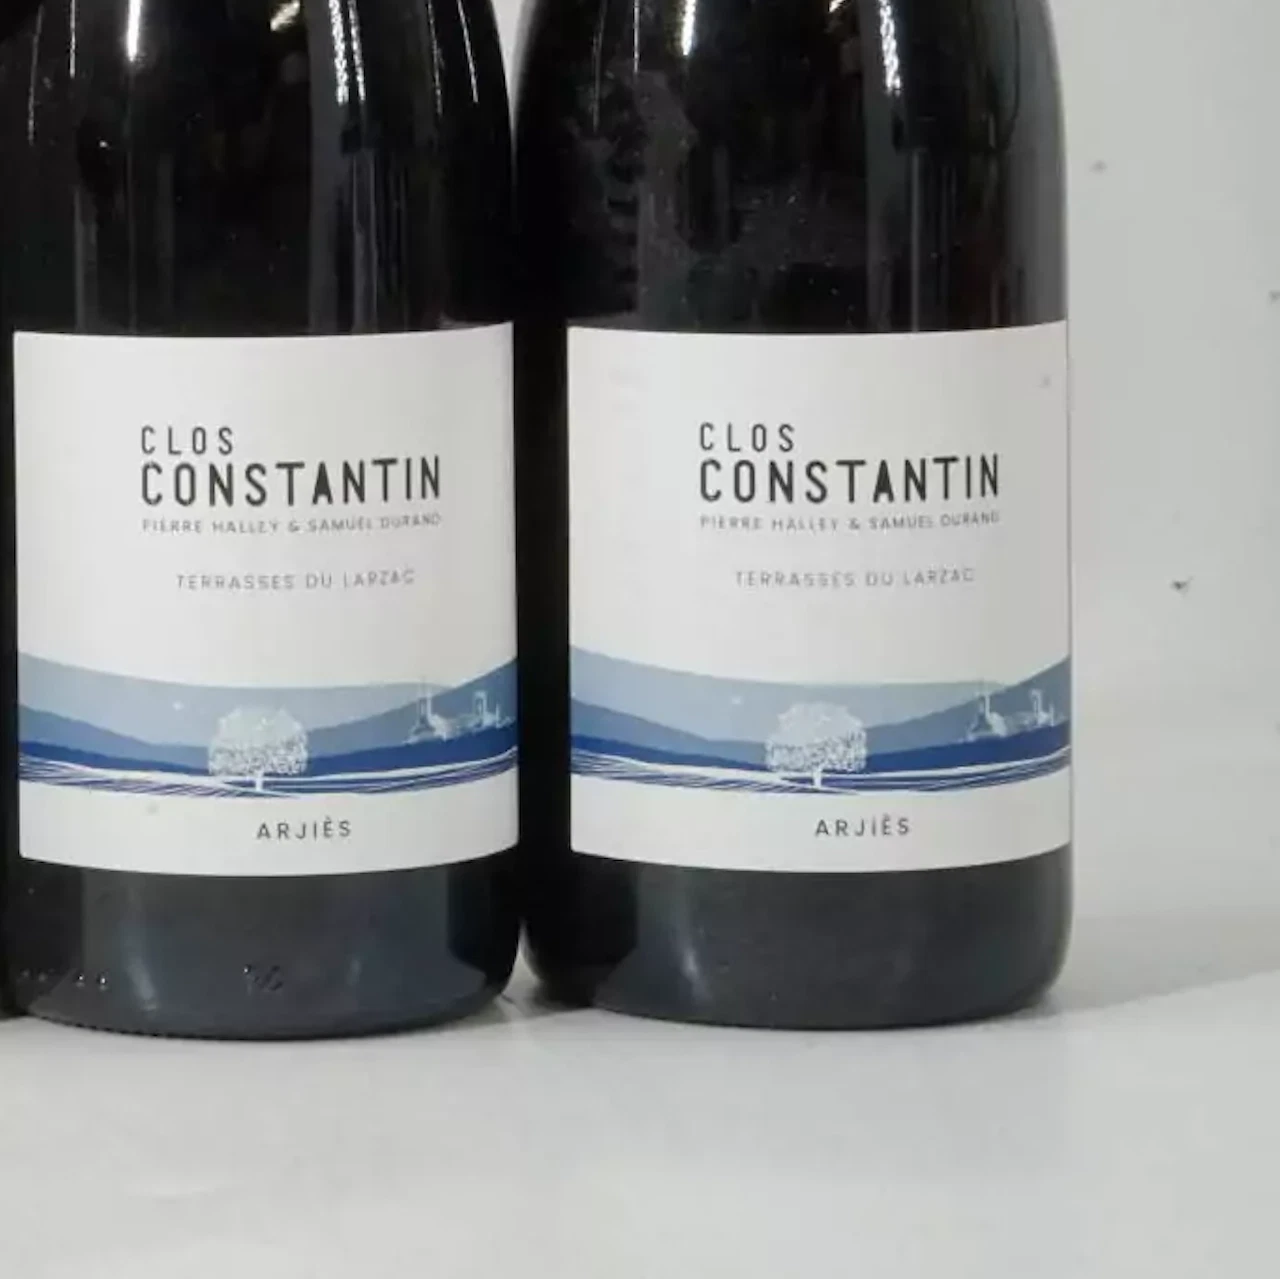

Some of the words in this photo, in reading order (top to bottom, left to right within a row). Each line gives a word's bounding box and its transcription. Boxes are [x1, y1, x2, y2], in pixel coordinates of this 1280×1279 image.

[140, 425, 235, 455] CLOS
[699, 421, 795, 453] CLOS
[140, 455, 440, 507] CONSTANTIN
[699, 452, 1000, 504] CONSTANTIN
[142, 518, 202, 534] PIERRE
[212, 518, 279, 534] HALLEY
[287, 519, 301, 534] &
[307, 517, 373, 534] SAMUEL
[380, 511, 441, 529] DURAND
[700, 514, 762, 531] PIERRE
[772, 516, 839, 532] HALLEY
[848, 517, 860, 531] &
[869, 514, 934, 531] SAMUEL
[940, 510, 1000, 528] DURAND
[176, 573, 294, 591] TERRASSES
[305, 573, 332, 589] DU
[343, 568, 414, 589] LARZAC
[736, 570, 855, 588] TERRASSES
[865, 570, 894, 587] DU
[903, 566, 975, 586] LARZAC
[256, 814, 352, 841] ARJIÈS
[814, 813, 910, 837] ARJIÈS
